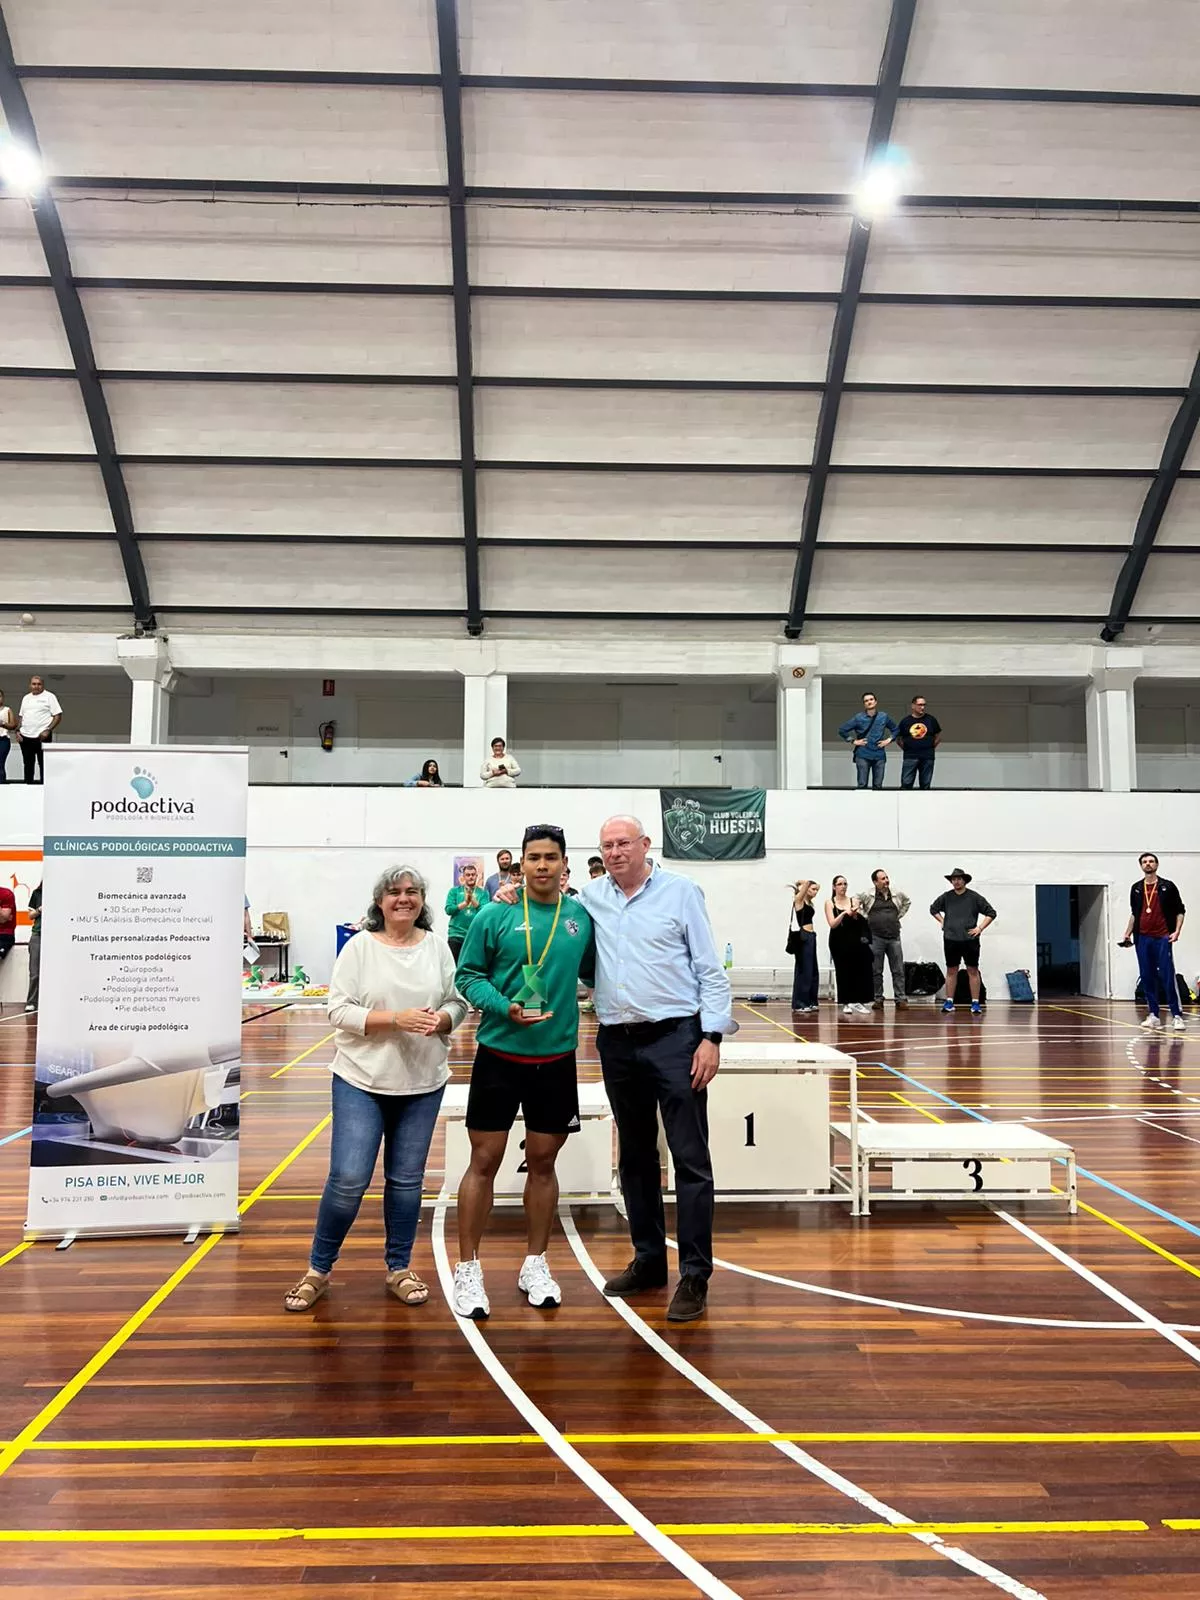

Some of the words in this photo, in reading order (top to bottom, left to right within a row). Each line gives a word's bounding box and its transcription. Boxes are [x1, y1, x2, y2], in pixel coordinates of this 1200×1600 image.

[91, 797, 195, 819] podoactiva
[713, 811, 730, 819] CLUB
[709, 818, 763, 834] HUESCA
[53, 840, 99, 851] CLÍNICAS
[101, 840, 171, 852] PODOLÓGICAS
[172, 843, 234, 852] PODOACTIVA
[98, 892, 148, 900] Biomecánica
[150, 892, 187, 900] avanzada
[72, 934, 109, 942] Plantillas
[111, 934, 168, 943] personalizadas
[170, 934, 210, 942] Podoactiva
[90, 953, 143, 961] Tratamientos
[145, 953, 192, 962] podológicos
[145, 985, 179, 993] deportiva
[133, 996, 167, 1004] personas
[148, 1023, 189, 1032] podológica
[743, 1111, 756, 1147] 1
[962, 1158, 984, 1192] 3
[65, 1176, 94, 1188] PISA
[97, 1175, 130, 1188] BIEN,
[133, 1174, 160, 1186] VIVE
[163, 1173, 205, 1185] MEJOR
